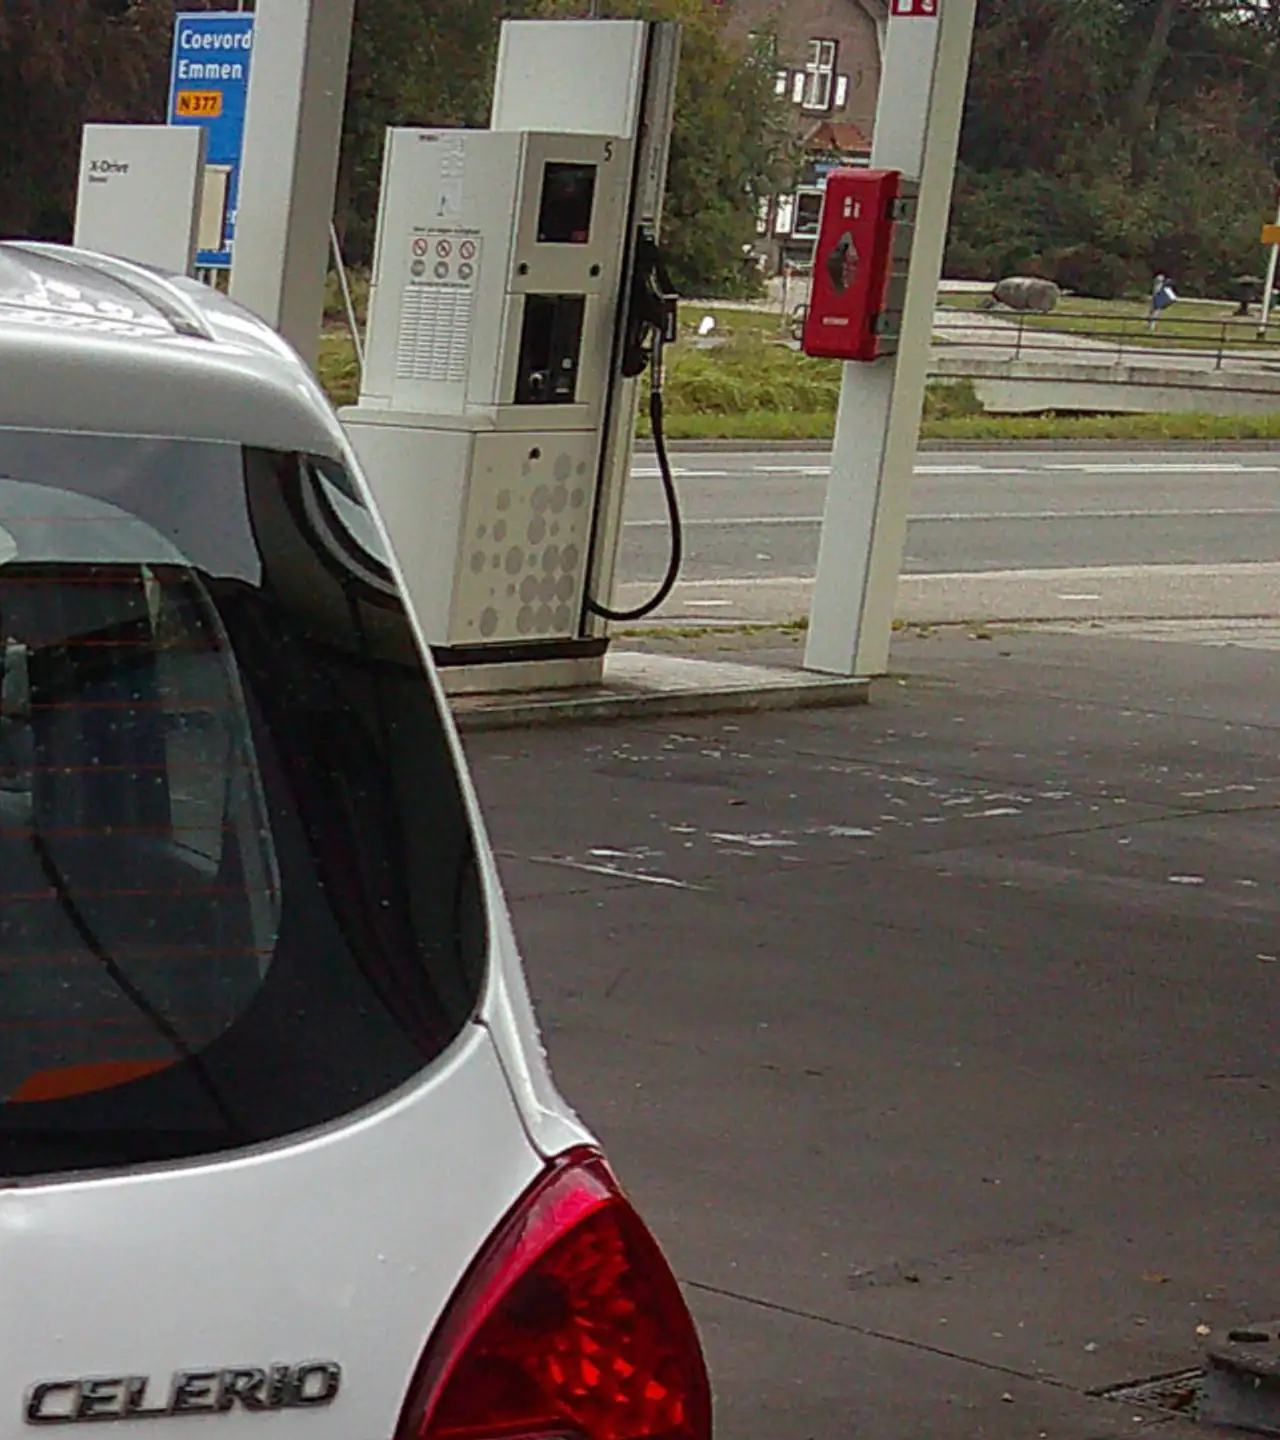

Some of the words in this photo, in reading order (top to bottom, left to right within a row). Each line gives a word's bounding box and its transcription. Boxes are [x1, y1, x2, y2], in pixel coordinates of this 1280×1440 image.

[178, 59, 243, 79] Emmen
[180, 96, 190, 111] N
[192, 95, 218, 111] 377
[24, 1358, 343, 1425] CELERIO
